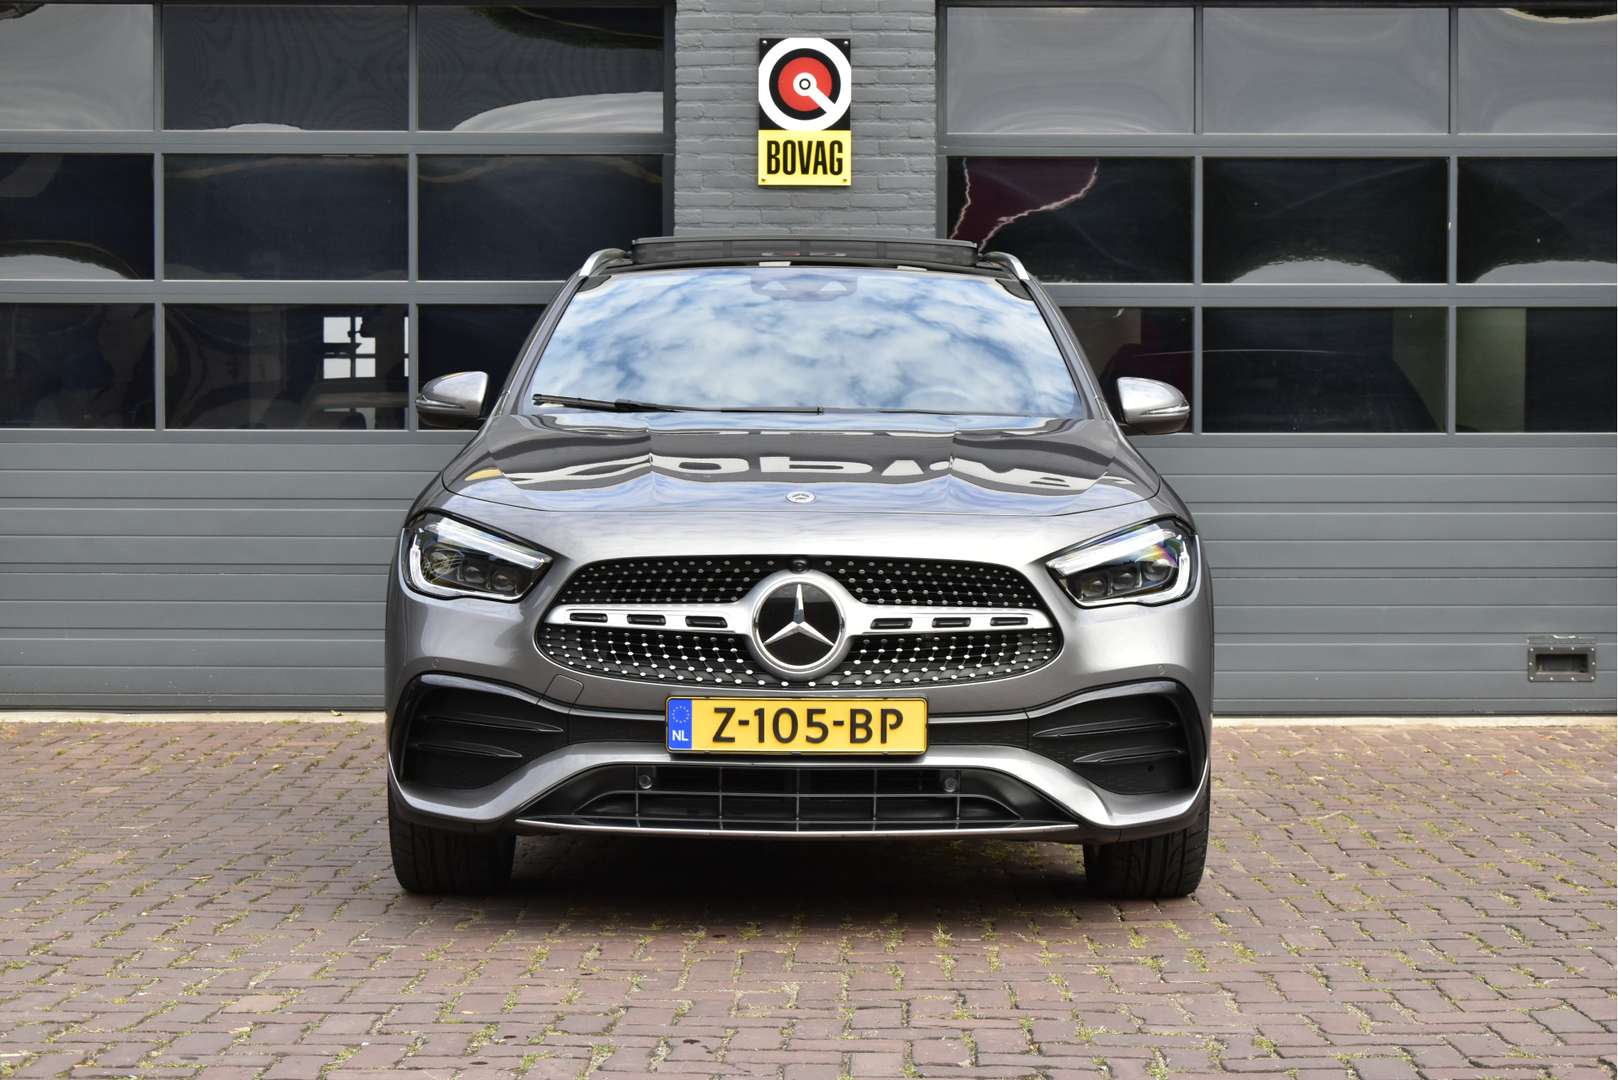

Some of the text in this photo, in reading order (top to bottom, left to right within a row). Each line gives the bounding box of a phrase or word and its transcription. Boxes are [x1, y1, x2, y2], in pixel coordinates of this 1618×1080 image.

[766, 140, 844, 176] BOVAG
[671, 729, 689, 742] NL
[712, 707, 904, 744] Z-105-BP
